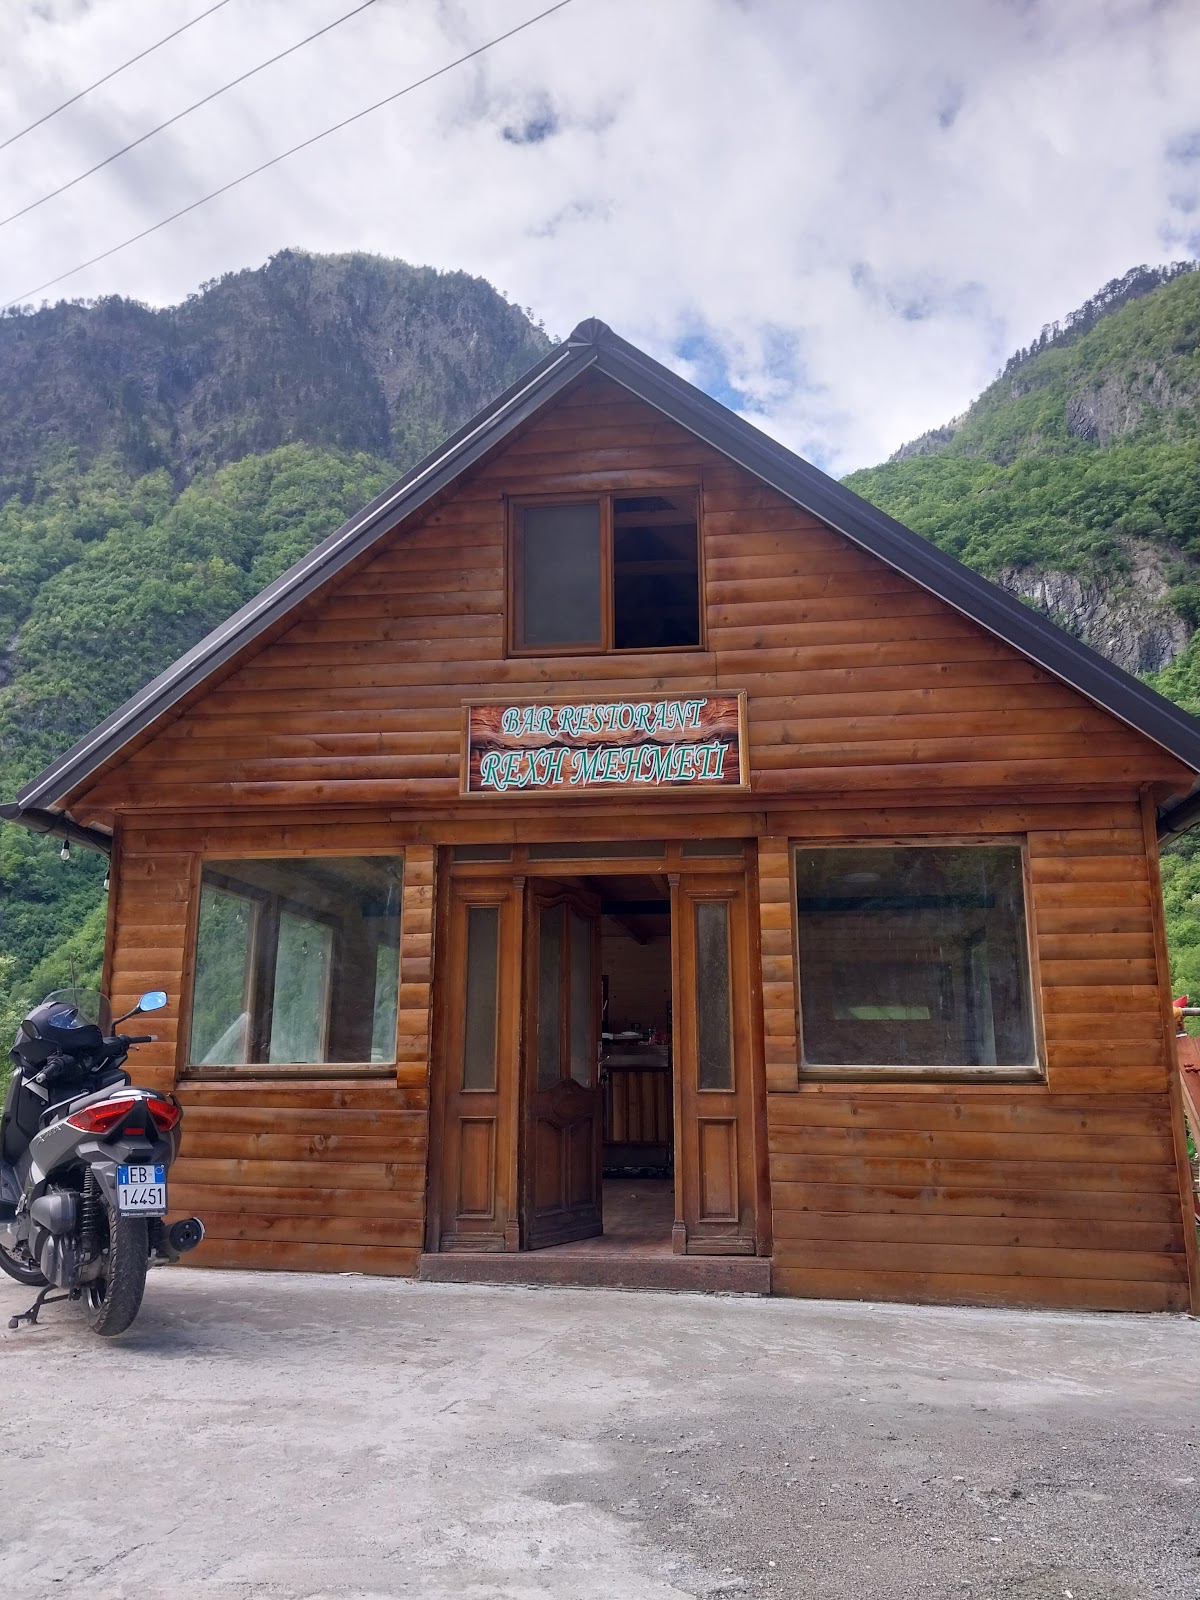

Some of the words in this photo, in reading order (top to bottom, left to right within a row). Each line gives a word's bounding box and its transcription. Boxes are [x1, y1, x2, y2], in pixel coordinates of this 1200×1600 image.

[502, 705, 557, 738] BAR
[558, 698, 707, 736] RESTORANT
[481, 748, 570, 791] REXH
[570, 742, 728, 787] MEHMETI
[130, 1167, 147, 1183] EB
[123, 1188, 162, 1206] 14451
